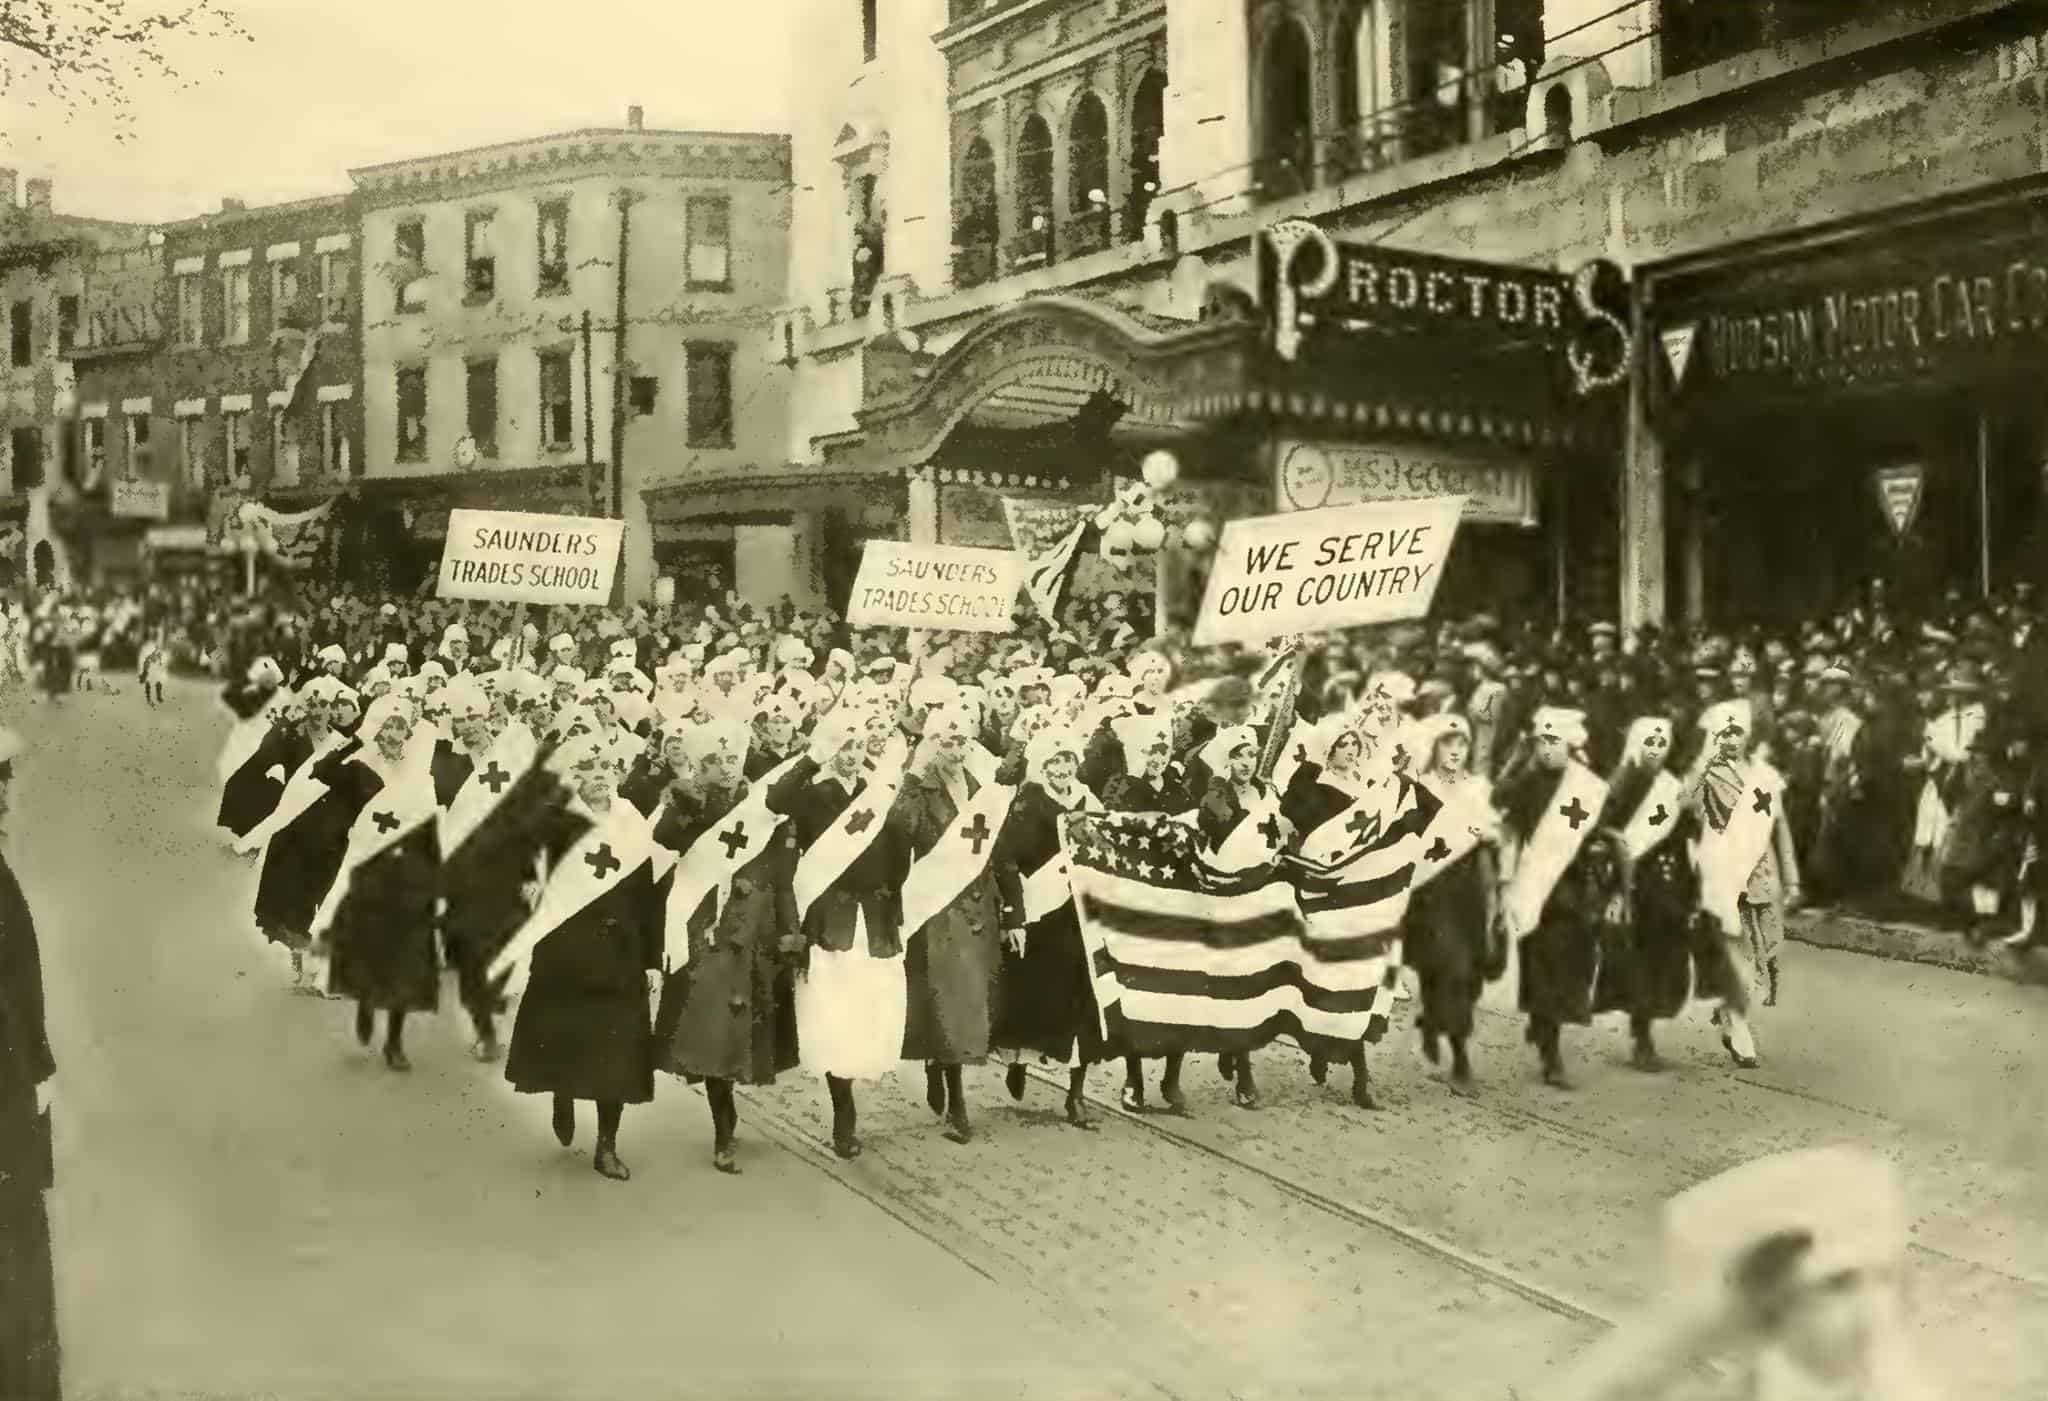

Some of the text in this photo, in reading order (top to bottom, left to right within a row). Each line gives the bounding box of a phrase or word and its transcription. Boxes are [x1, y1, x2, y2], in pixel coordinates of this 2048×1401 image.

[1264, 217, 1632, 395] PROCTOR'S
[1823, 289, 1920, 360] MOTOR
[1933, 275, 1995, 339] CAR
[472, 526, 599, 557] SAUNDERS
[1245, 525, 1433, 576] WE SERVE
[449, 558, 602, 592] TRADES SCHOOL
[886, 557, 998, 585] SAUNDERS
[1218, 562, 1434, 617] OUR COUNTRY
[862, 587, 933, 614] TRADES
